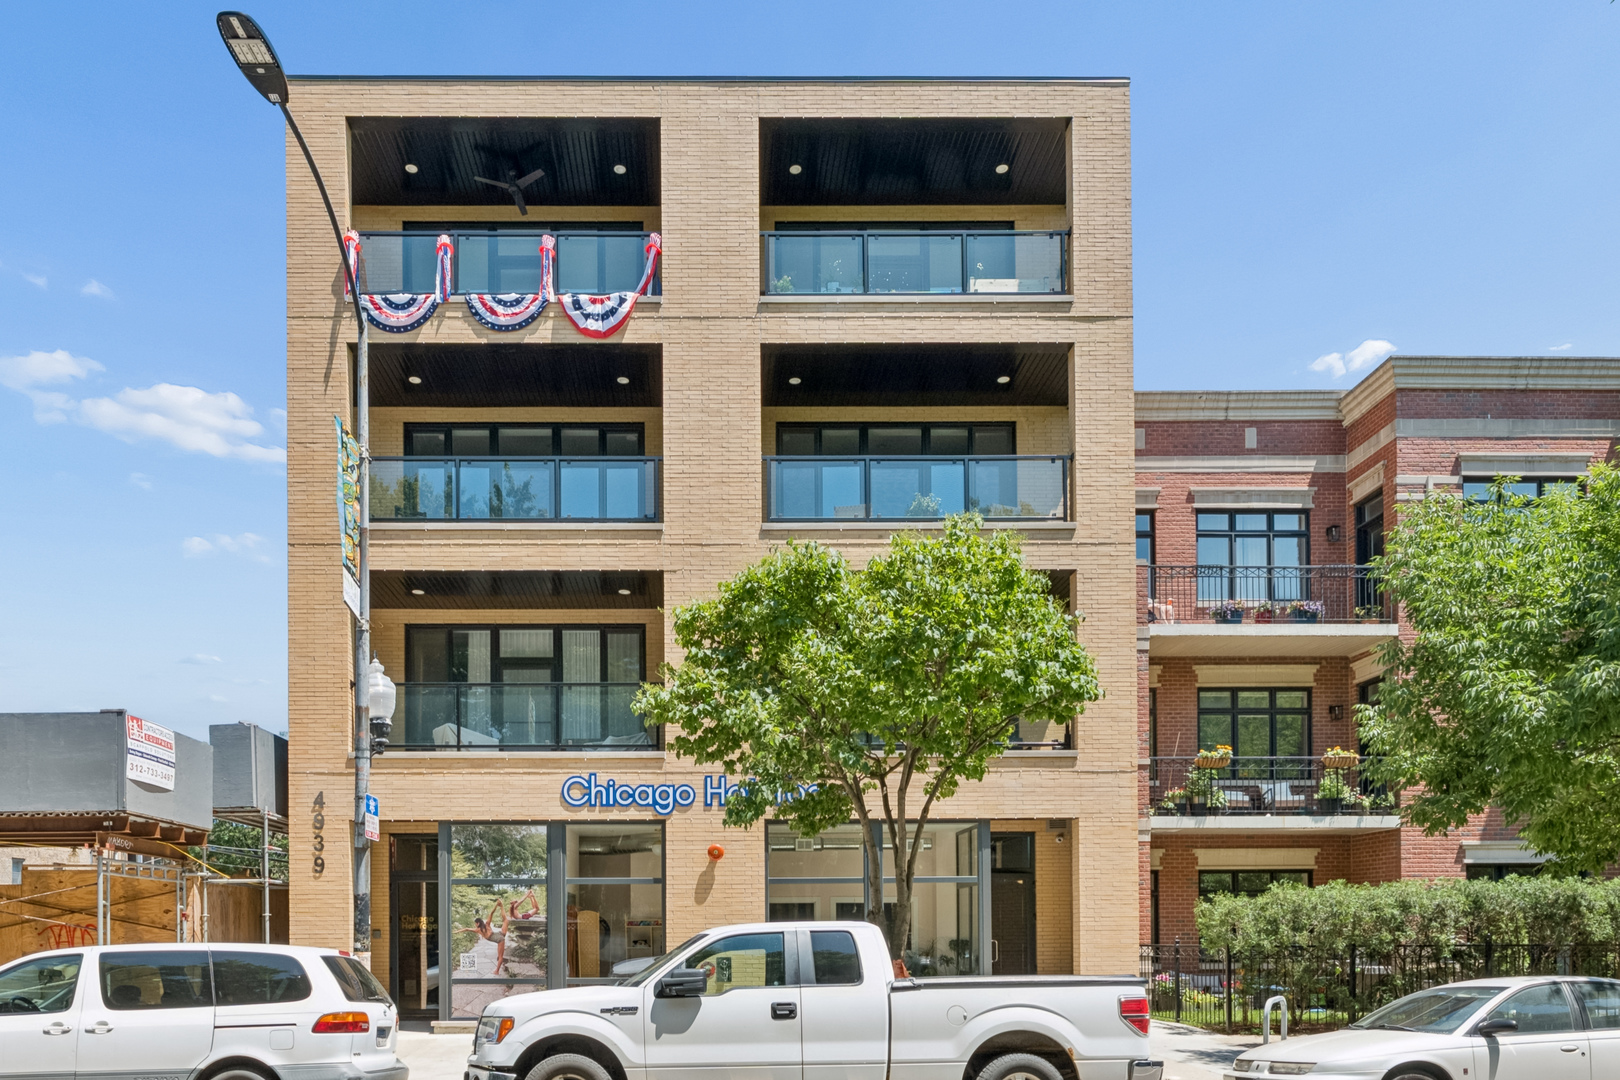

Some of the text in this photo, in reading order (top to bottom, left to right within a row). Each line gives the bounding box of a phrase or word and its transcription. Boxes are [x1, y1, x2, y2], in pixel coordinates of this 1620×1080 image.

[145, 734, 173, 750] EQUIPMENT
[562, 773, 696, 816] Chicago
[313, 791, 325, 873] 4939
[401, 914, 434, 924] Chicago
[419, 922, 438, 931] Yoga
